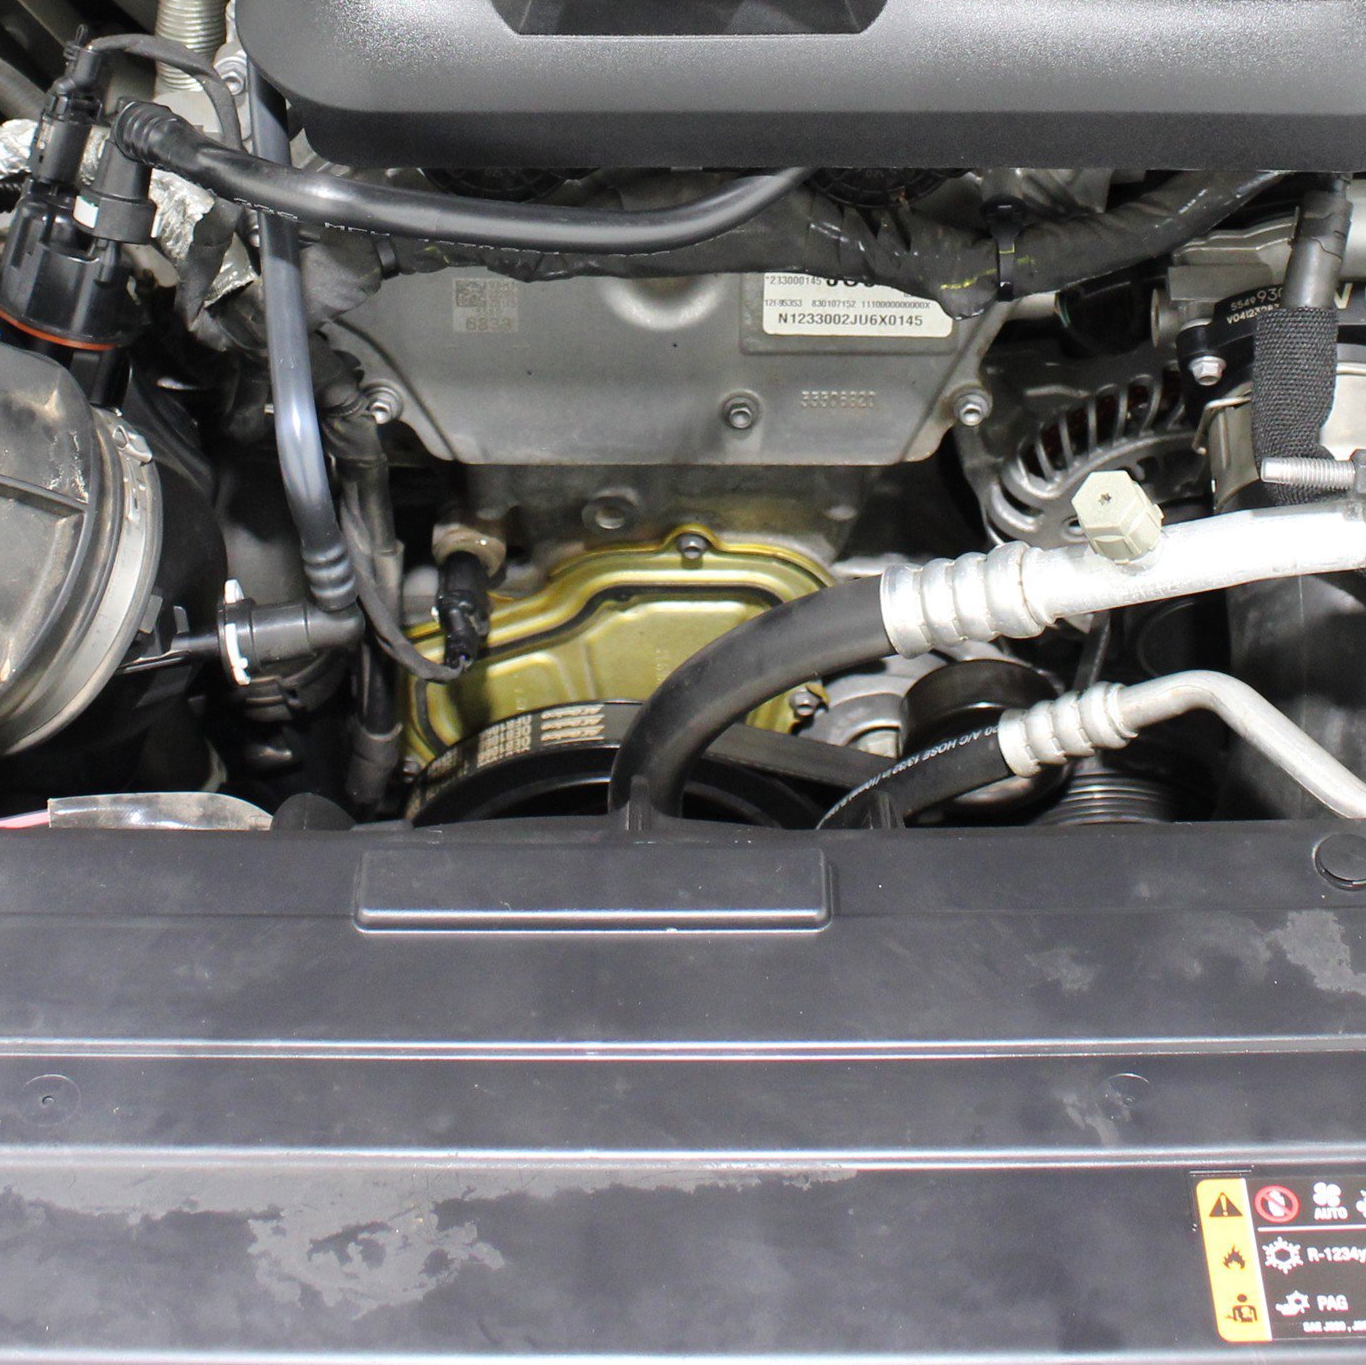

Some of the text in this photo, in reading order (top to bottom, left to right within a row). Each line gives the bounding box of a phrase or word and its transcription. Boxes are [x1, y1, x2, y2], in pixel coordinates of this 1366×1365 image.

[778, 312, 923, 327] N1233002JU6X0145
[959, 730, 983, 746] A/C
[922, 738, 956, 761] HOSE
[1314, 1206, 1348, 1220] AUTO
[1317, 1294, 1348, 1311] PAG
